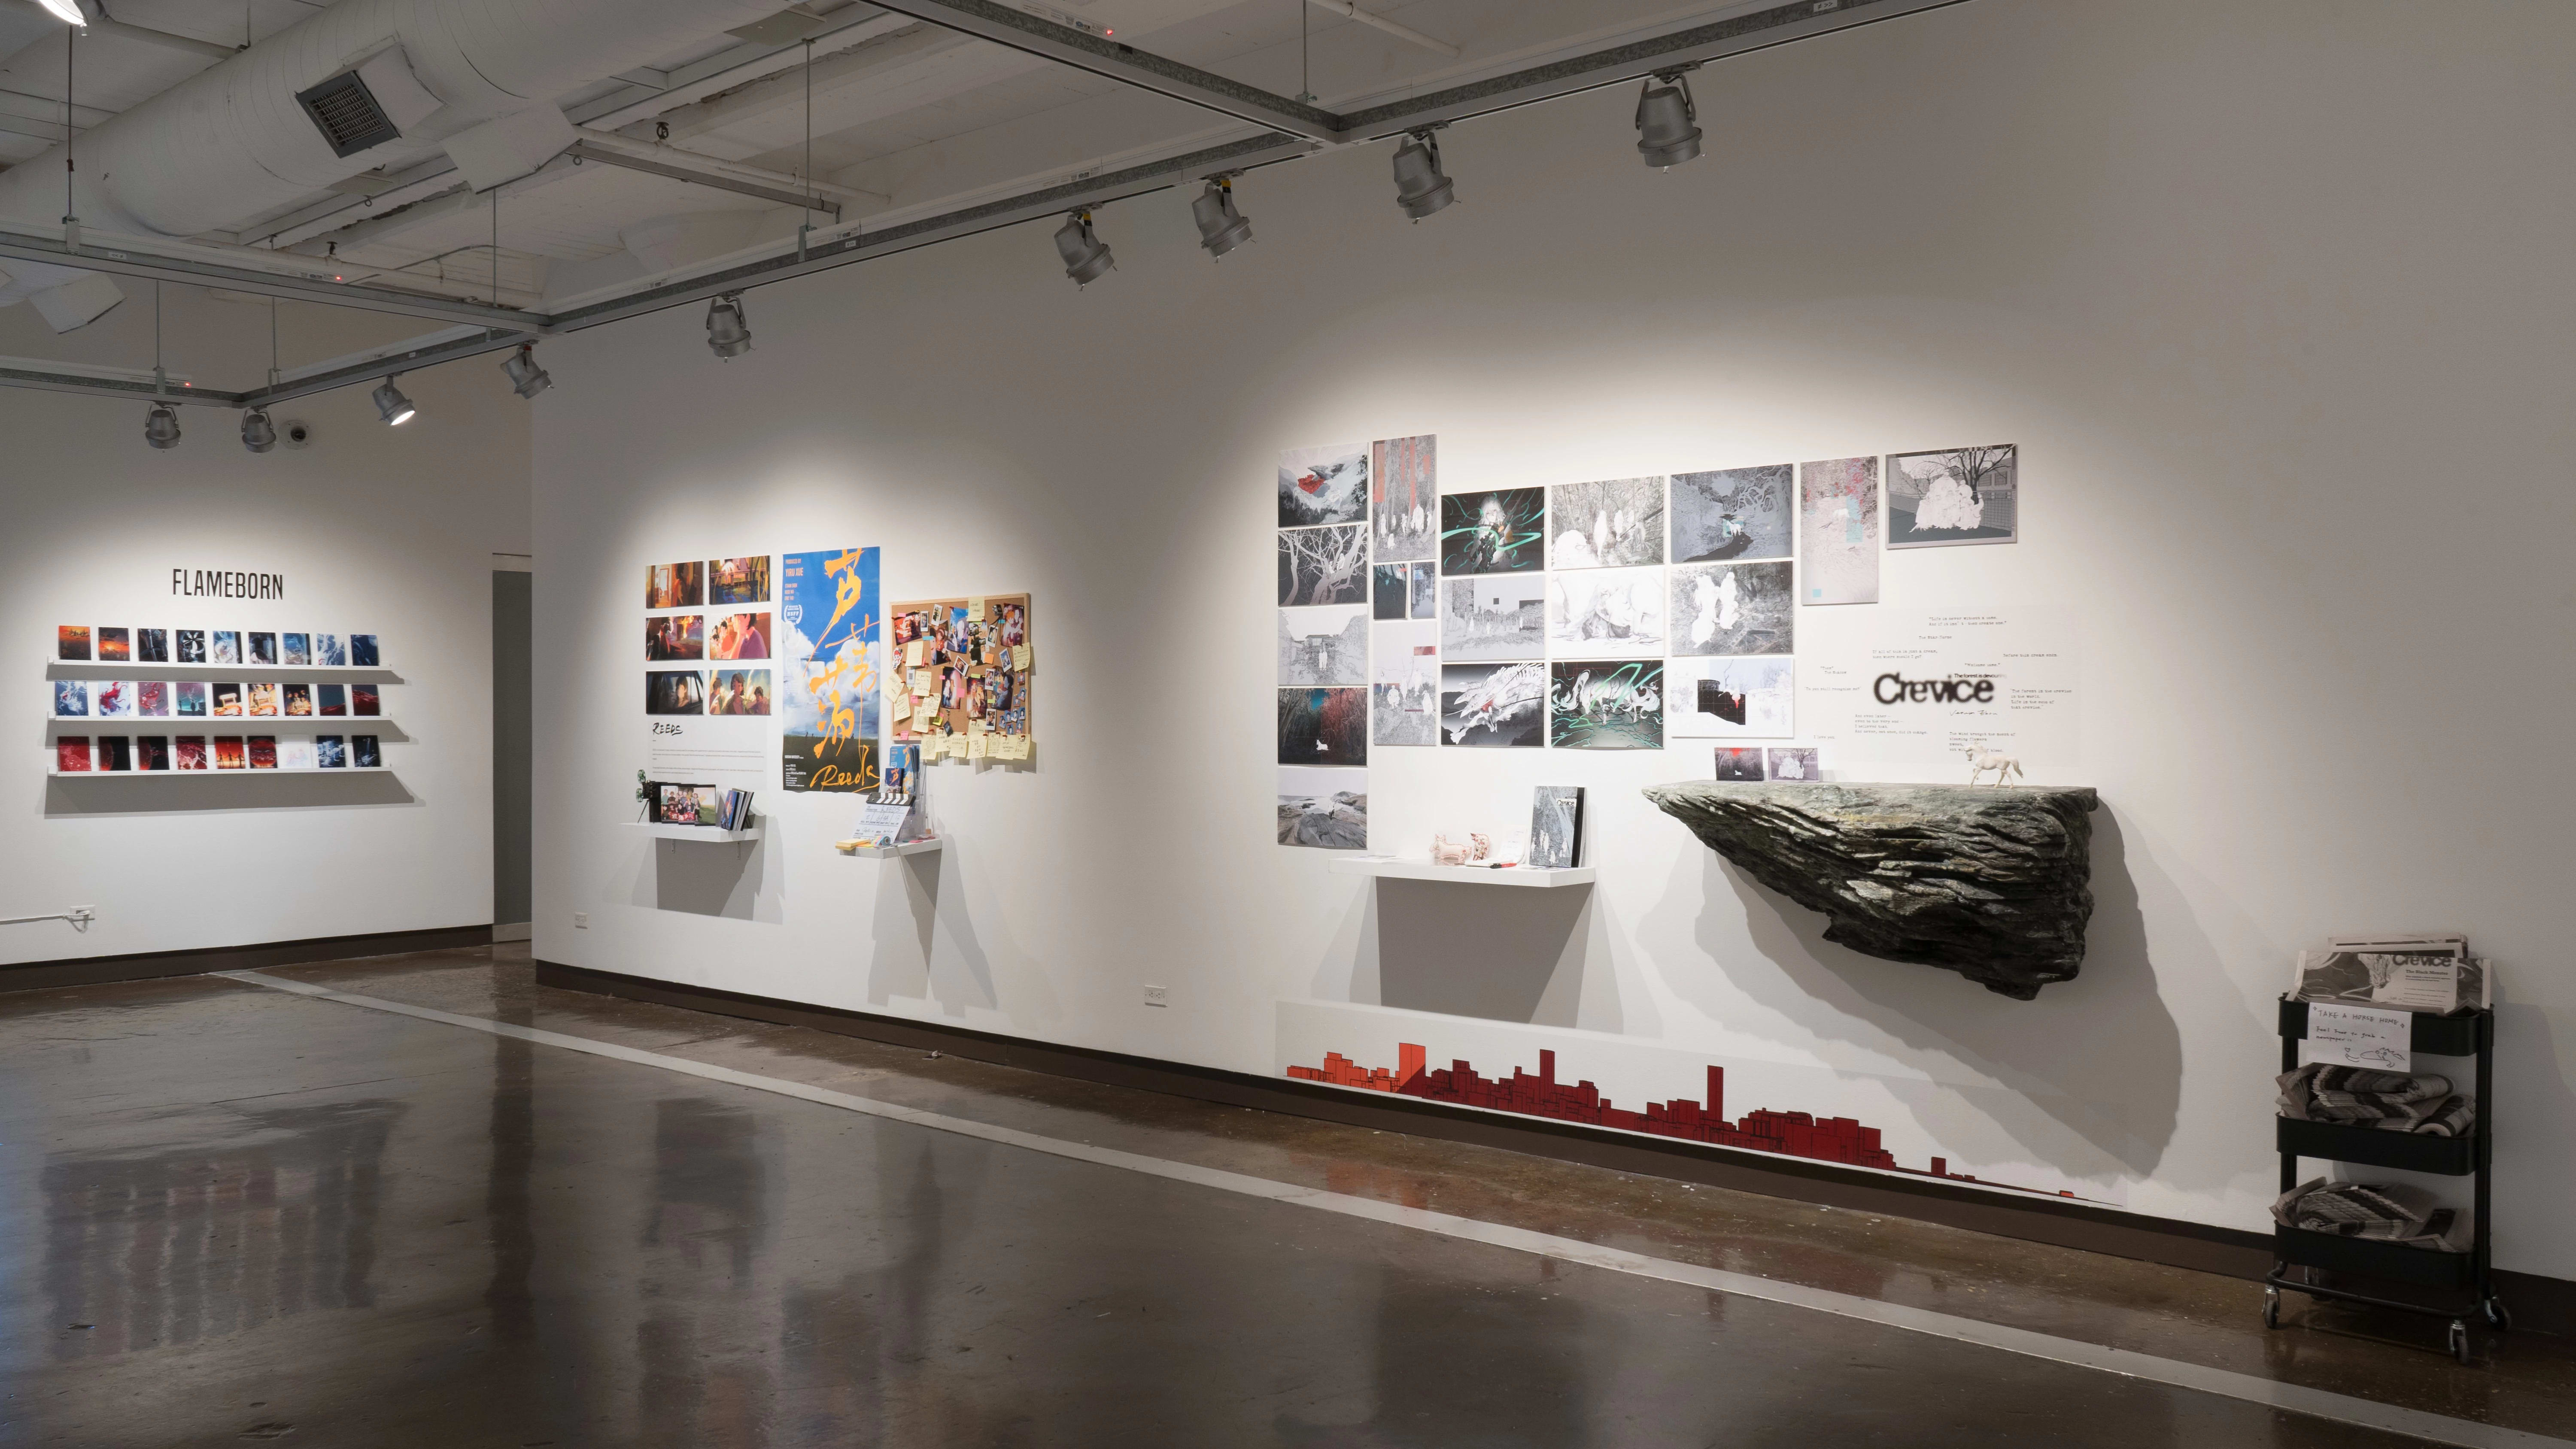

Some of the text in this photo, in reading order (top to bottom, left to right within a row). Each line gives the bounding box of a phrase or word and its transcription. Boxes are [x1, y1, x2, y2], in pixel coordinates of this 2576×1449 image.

[173, 569, 283, 600] FLAMEBORN
[1873, 672, 1995, 705] Crevice
[653, 722, 683, 736] REEDS
[2393, 955, 2451, 967] Crevice
[2318, 1010, 2339, 1019] TAKE
